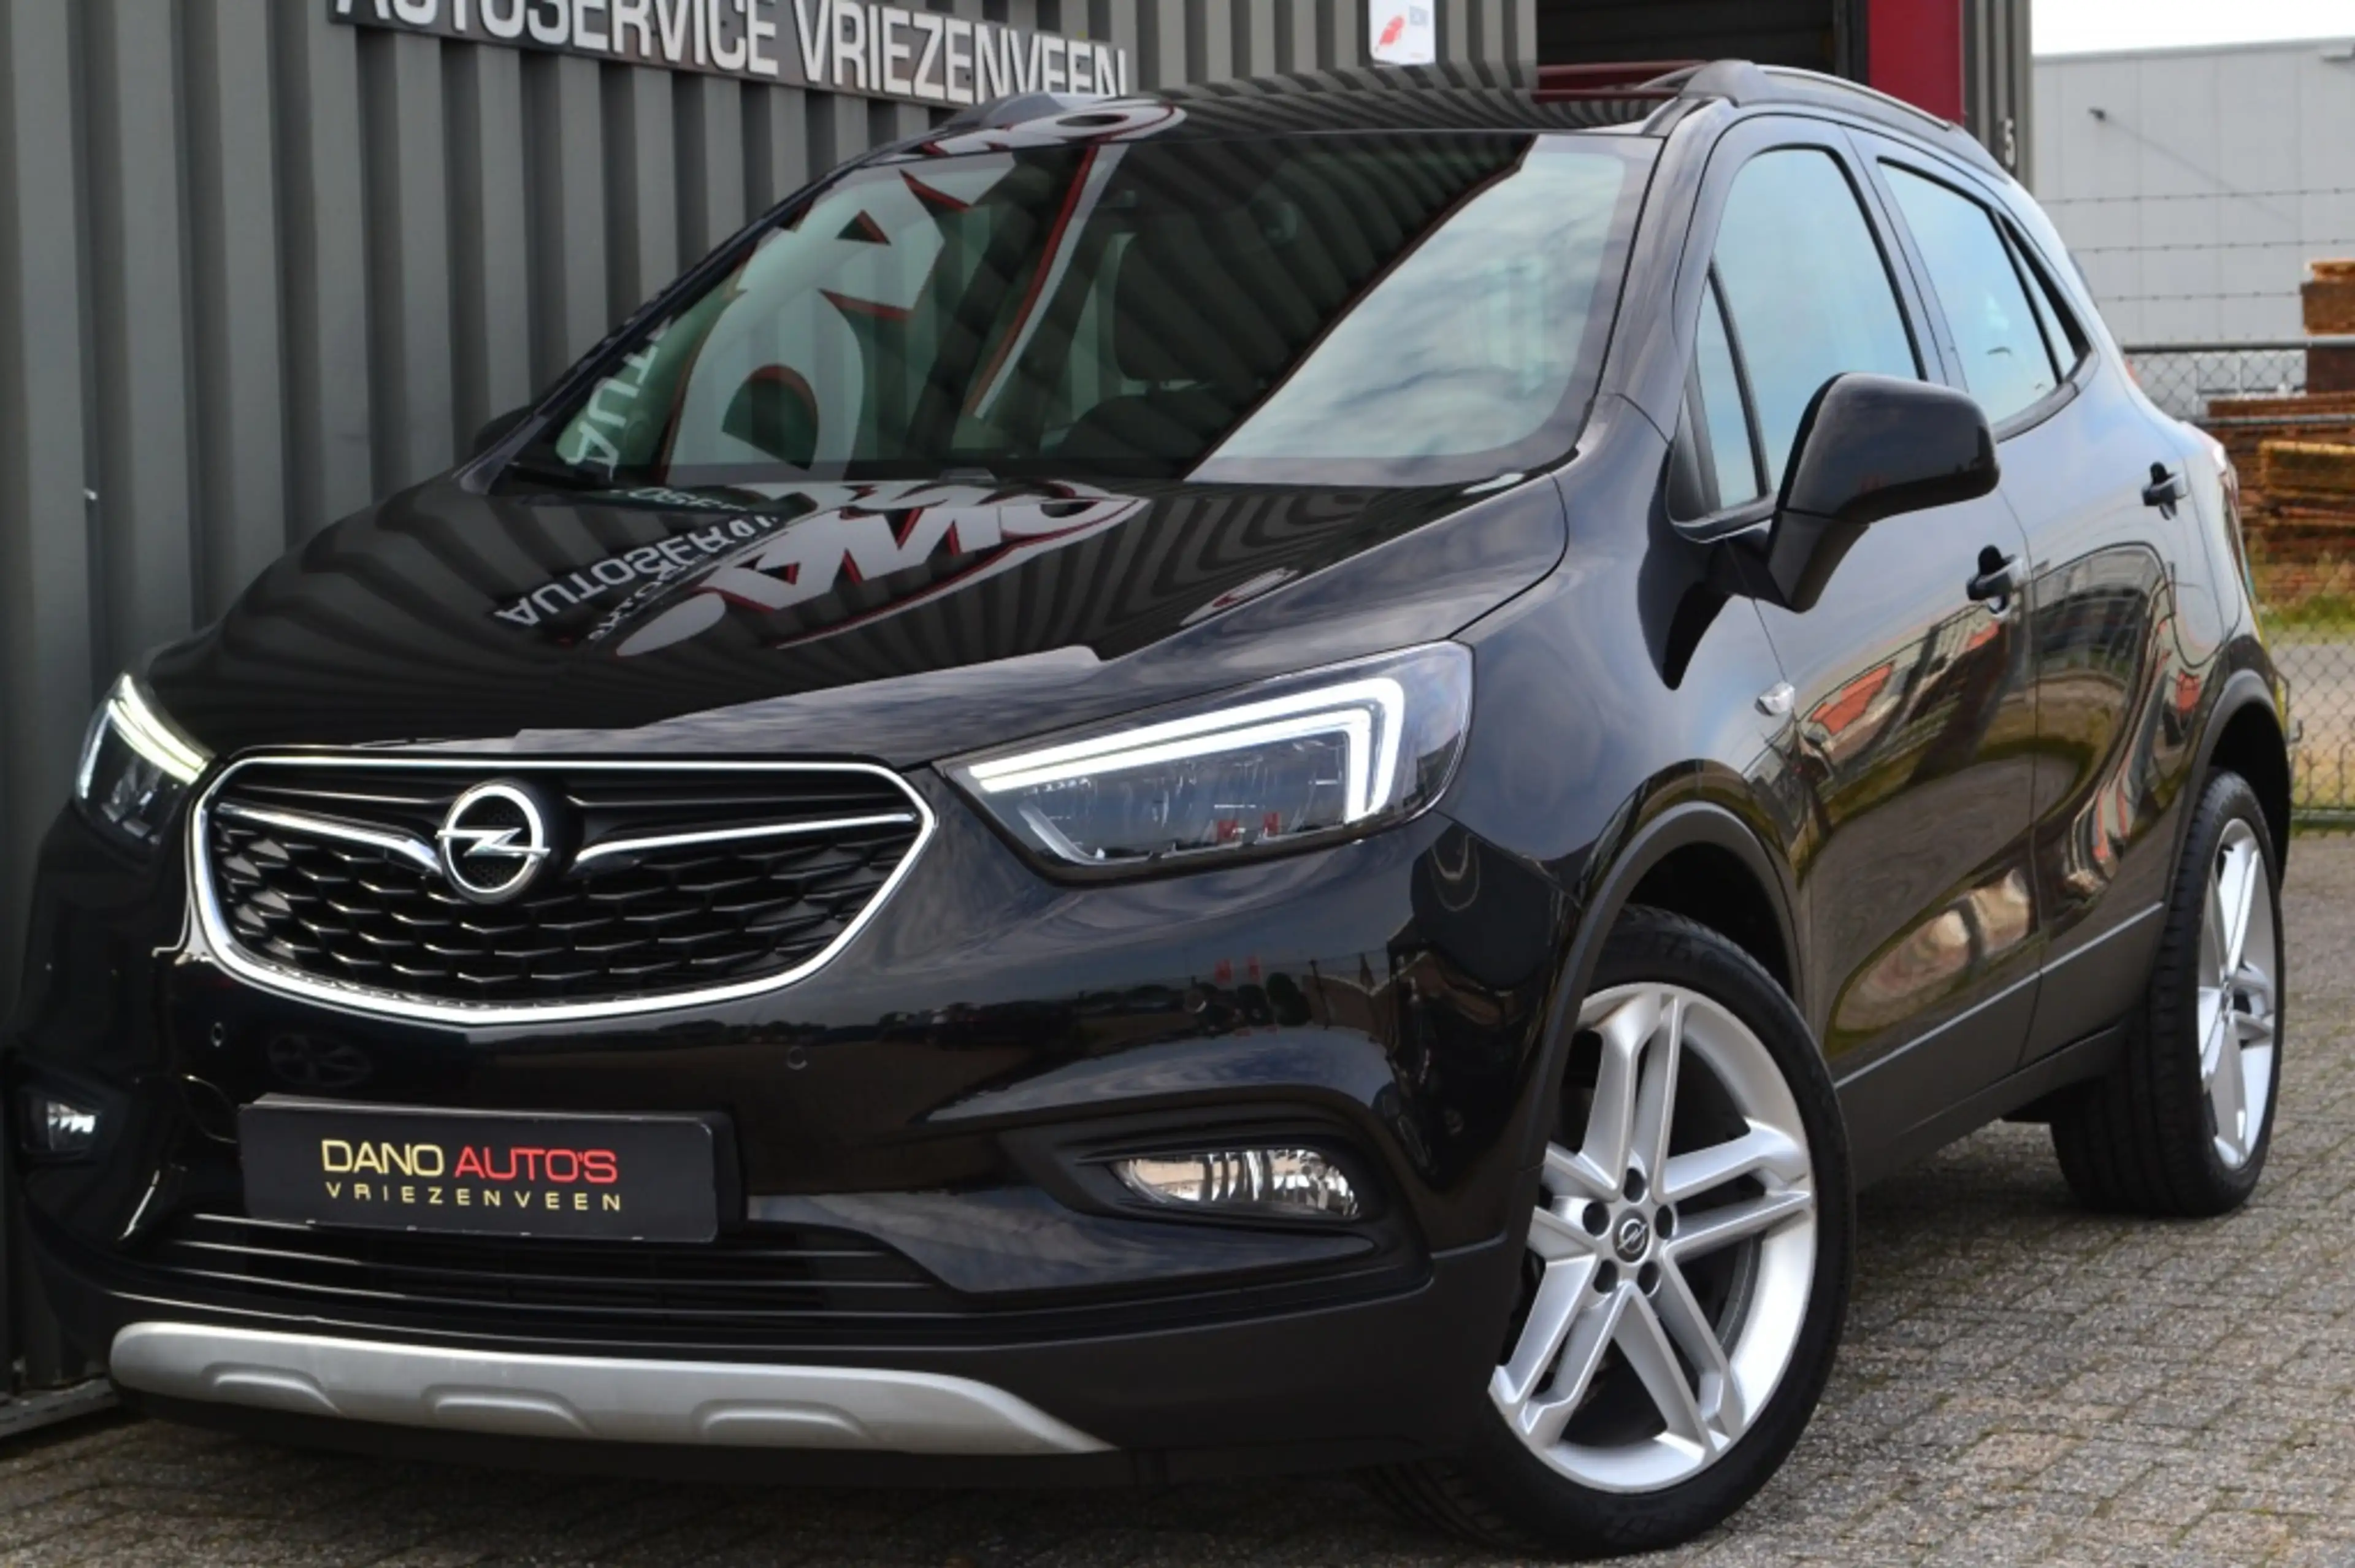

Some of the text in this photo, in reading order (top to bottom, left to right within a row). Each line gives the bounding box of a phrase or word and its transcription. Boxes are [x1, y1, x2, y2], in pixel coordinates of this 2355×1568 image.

[335, 0, 1127, 104] ERVICE VRIEZENVEEN
[321, 1139, 618, 1183] DANO AUTO'S
[326, 1182, 621, 1212] VRIEZENVEEN
